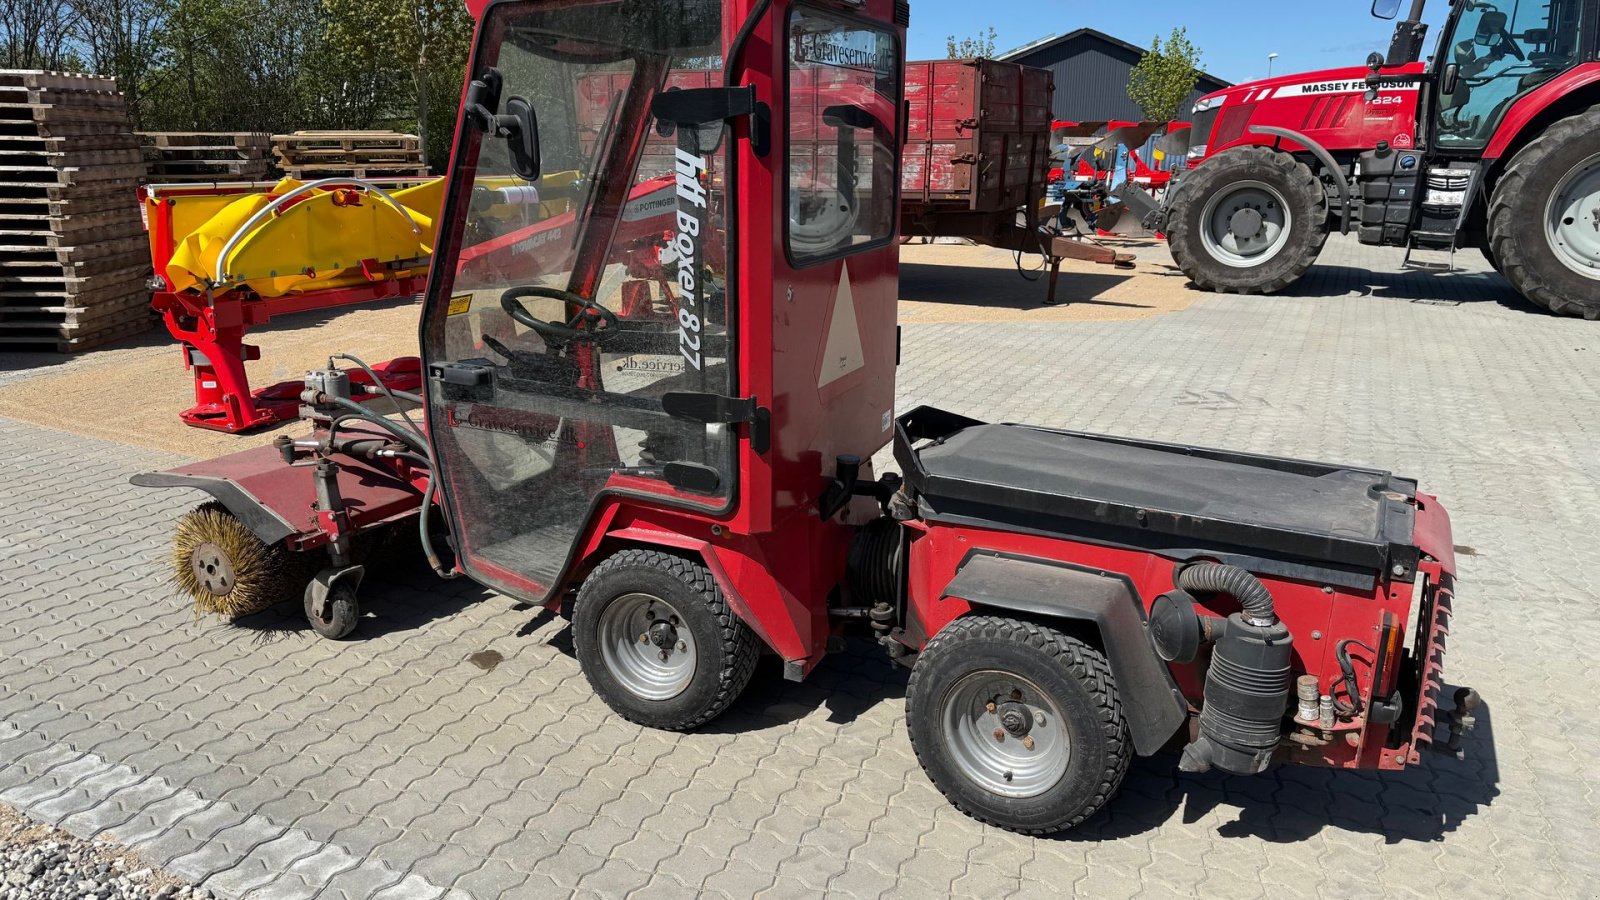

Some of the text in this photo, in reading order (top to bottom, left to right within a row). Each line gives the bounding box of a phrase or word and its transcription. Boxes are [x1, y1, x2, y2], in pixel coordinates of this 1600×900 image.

[1302, 80, 1415, 93] MASSEY FEUSON
[676, 209, 700, 307] Boxer
[679, 308, 701, 371] 827
